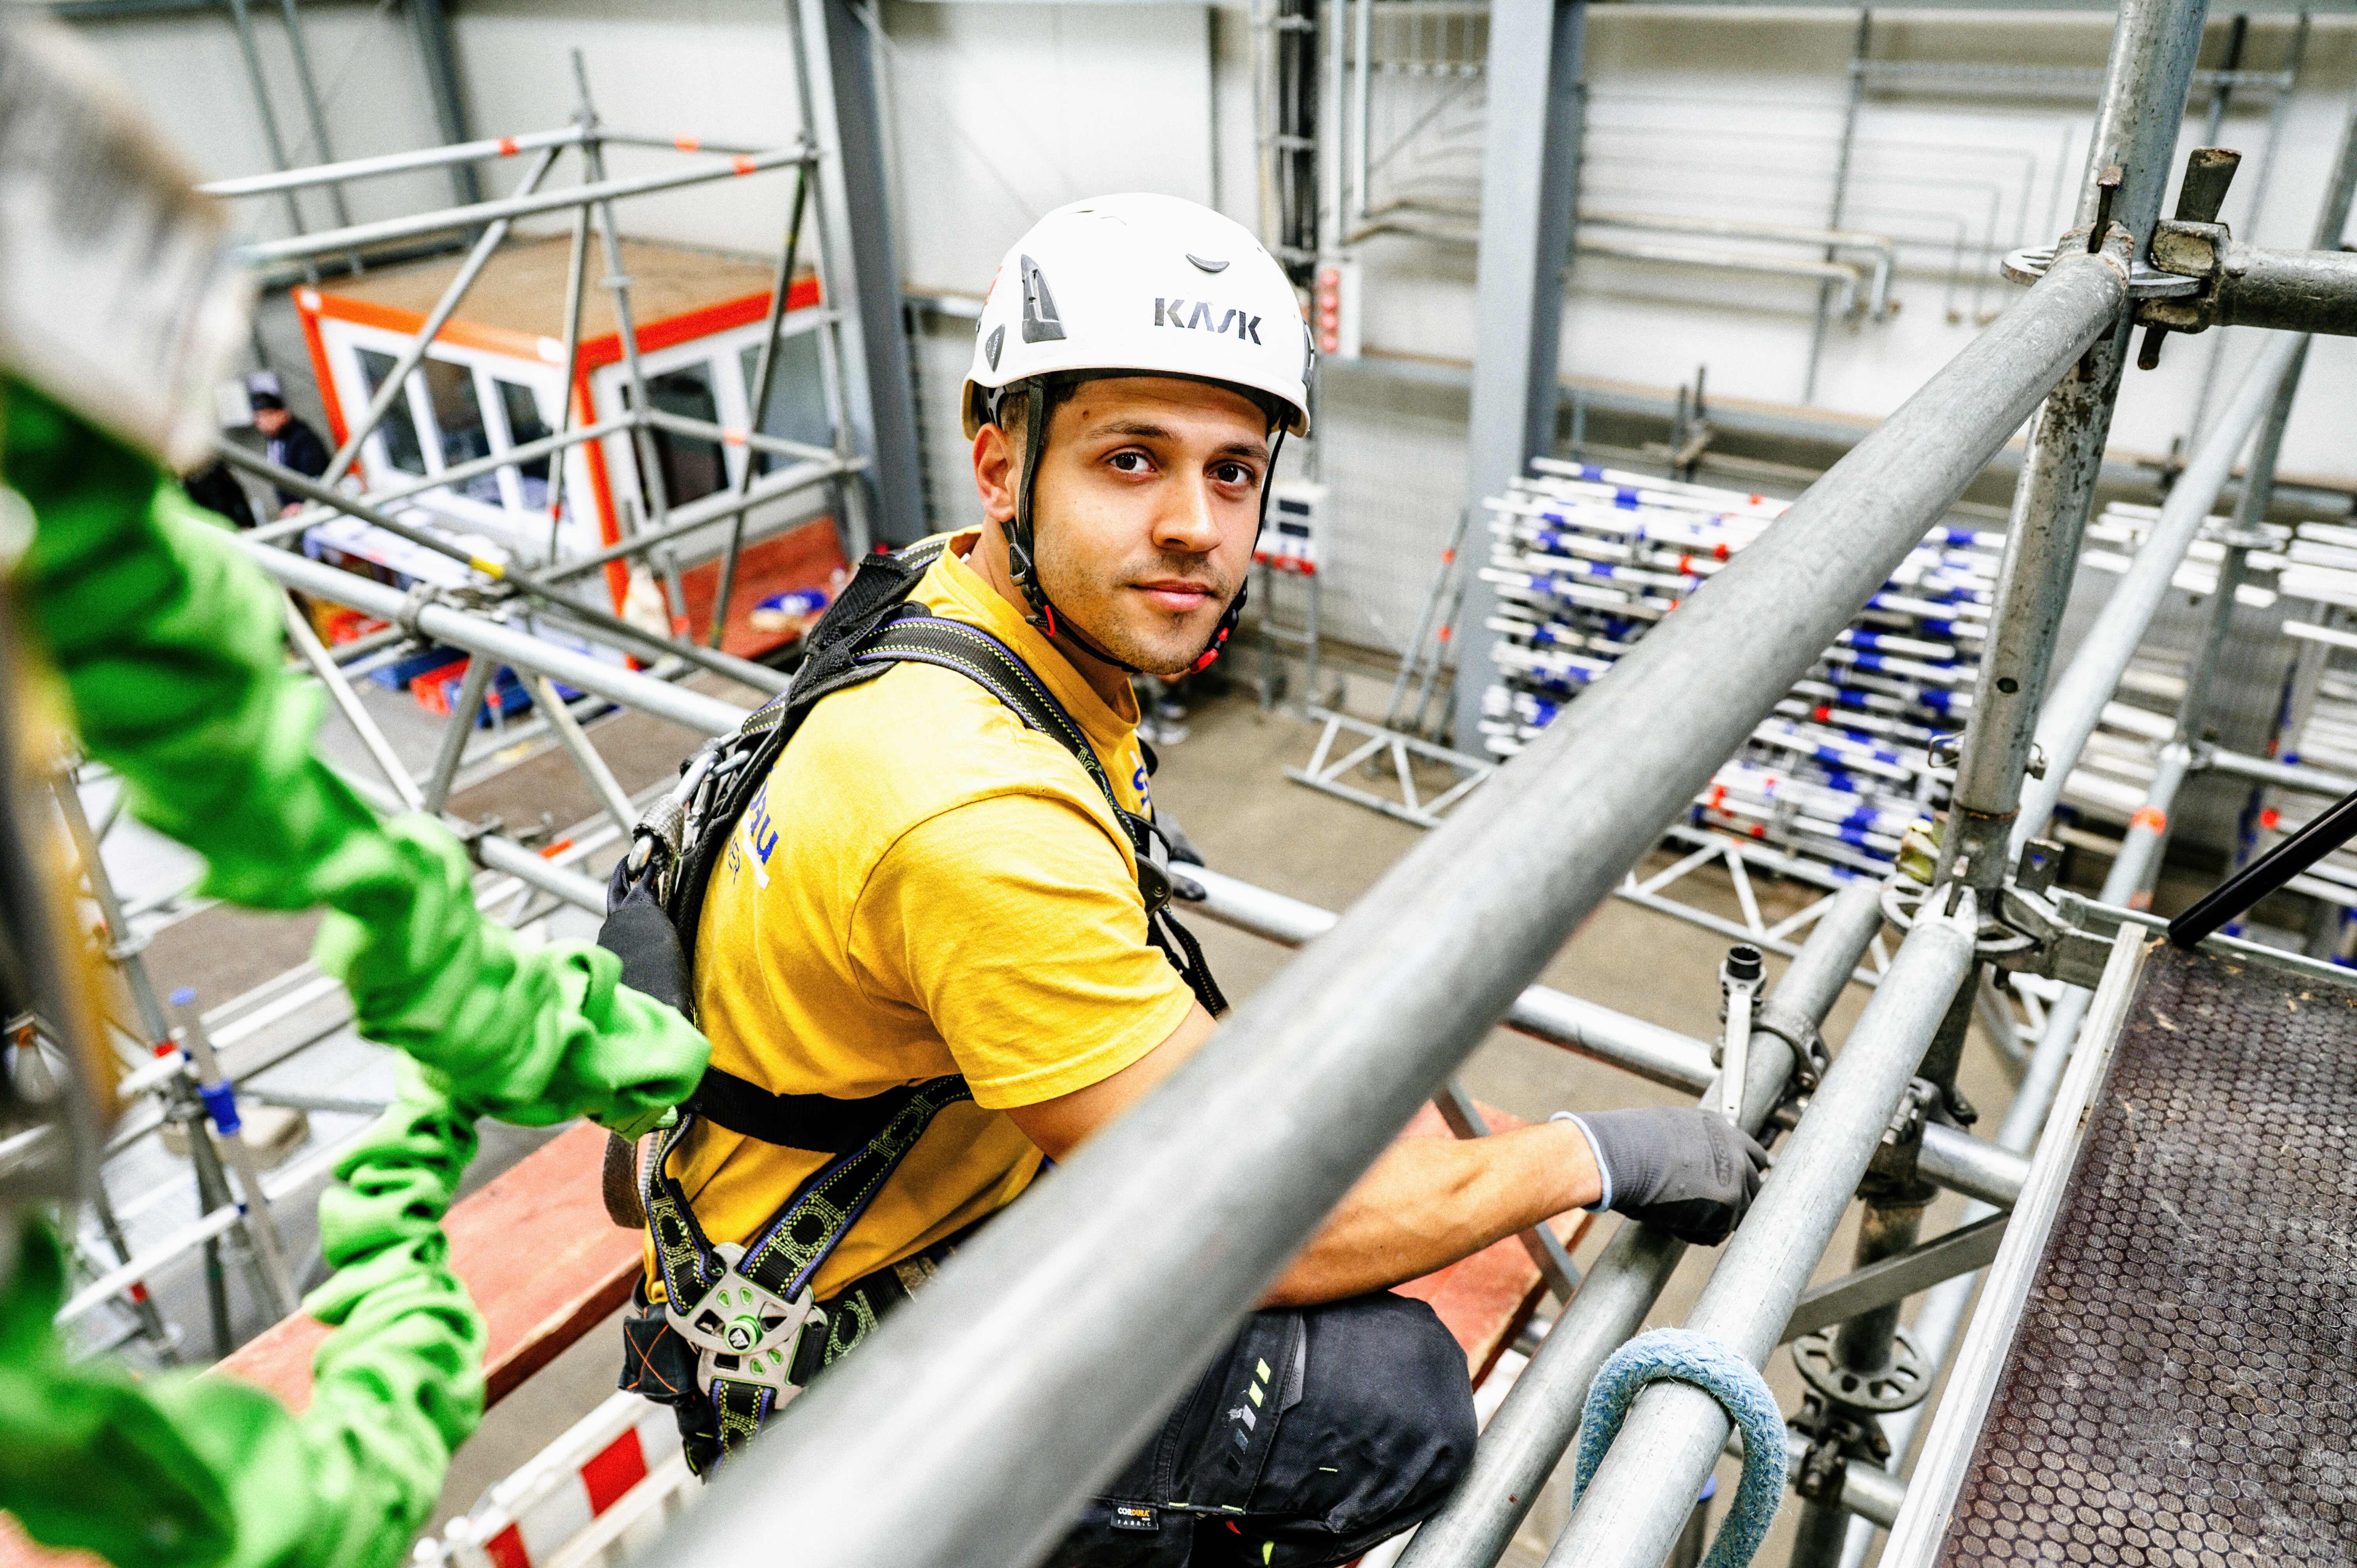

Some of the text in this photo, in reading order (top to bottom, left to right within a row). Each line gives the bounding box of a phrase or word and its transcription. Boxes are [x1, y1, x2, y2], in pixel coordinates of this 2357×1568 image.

[1154, 298, 1262, 346] KASK
[991, 333, 999, 359] VISOR
[1118, 1507, 1150, 1517] CORDURA
